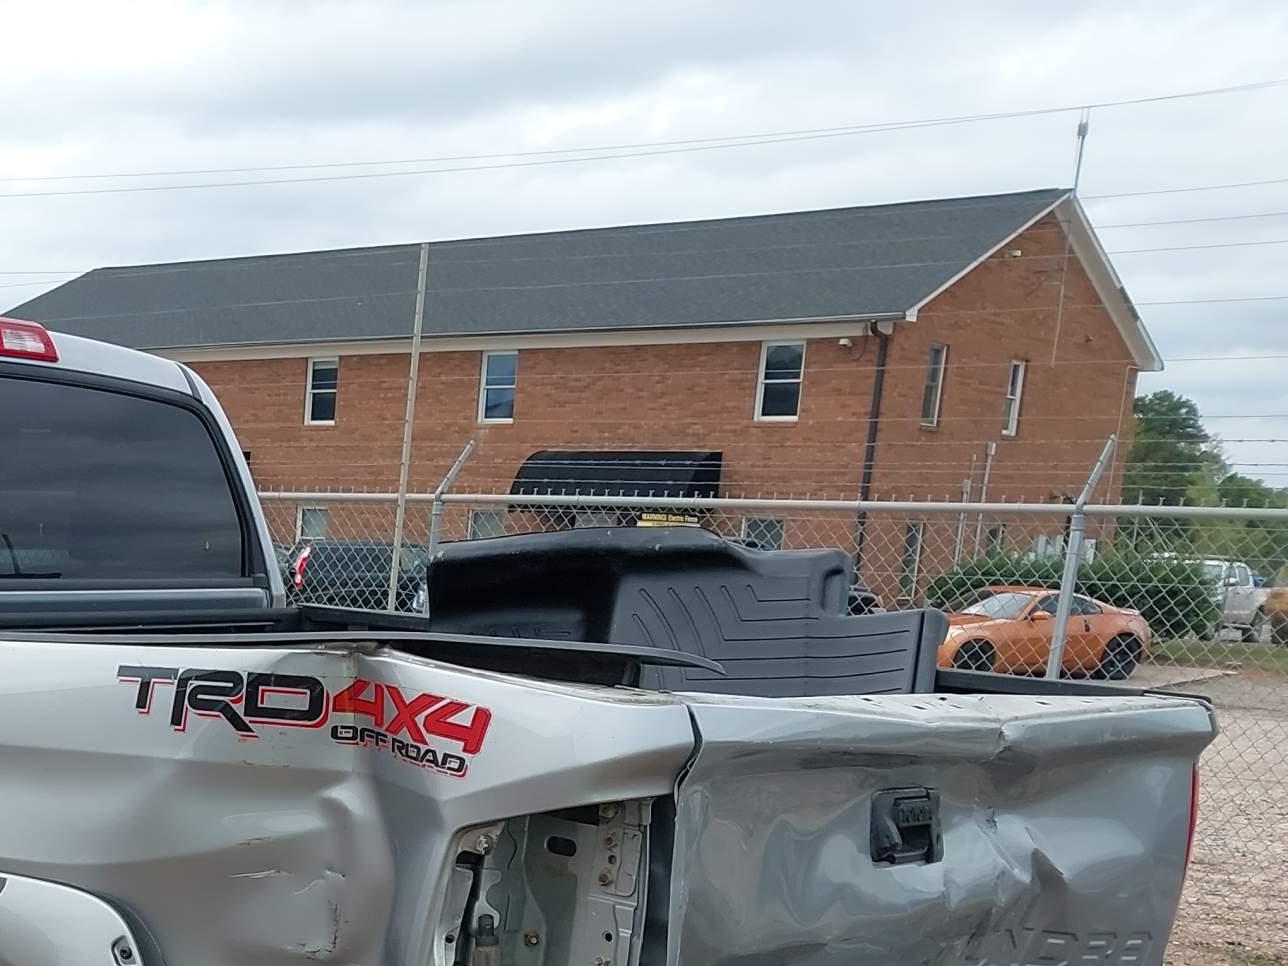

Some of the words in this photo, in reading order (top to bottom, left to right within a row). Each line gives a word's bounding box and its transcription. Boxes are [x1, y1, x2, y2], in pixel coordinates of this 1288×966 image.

[117, 666, 330, 740] TRD
[331, 725, 389, 750] OFF
[391, 737, 469, 779] ROAD
